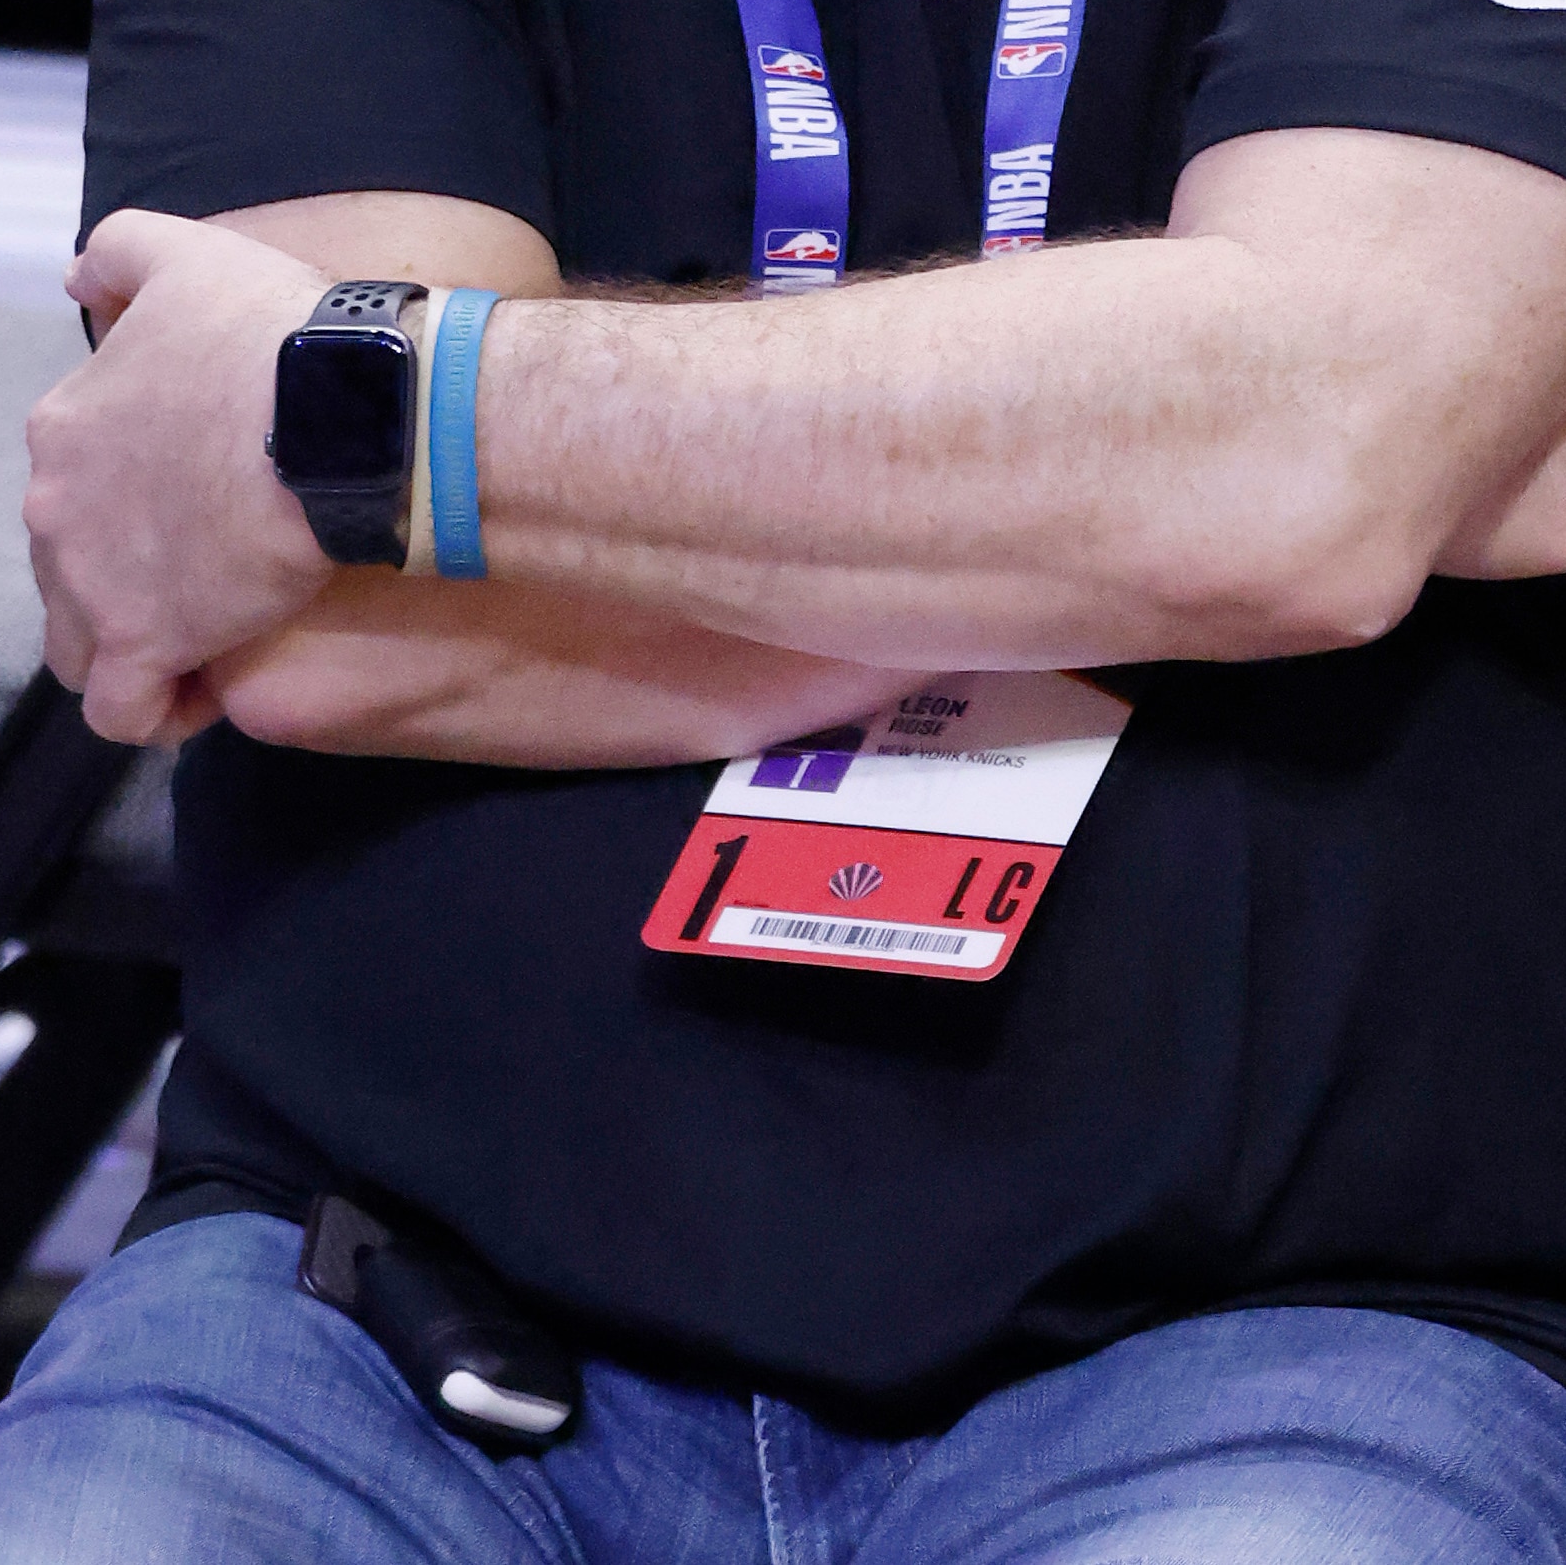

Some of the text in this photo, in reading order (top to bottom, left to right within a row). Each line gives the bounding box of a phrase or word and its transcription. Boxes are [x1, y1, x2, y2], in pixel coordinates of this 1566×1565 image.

[764, 78, 840, 161] NBA
[986, 143, 1054, 231] NBA
[899, 696, 969, 718] LEON
[965, 751, 1027, 769] KNICKS
[679, 835, 749, 941] 1
